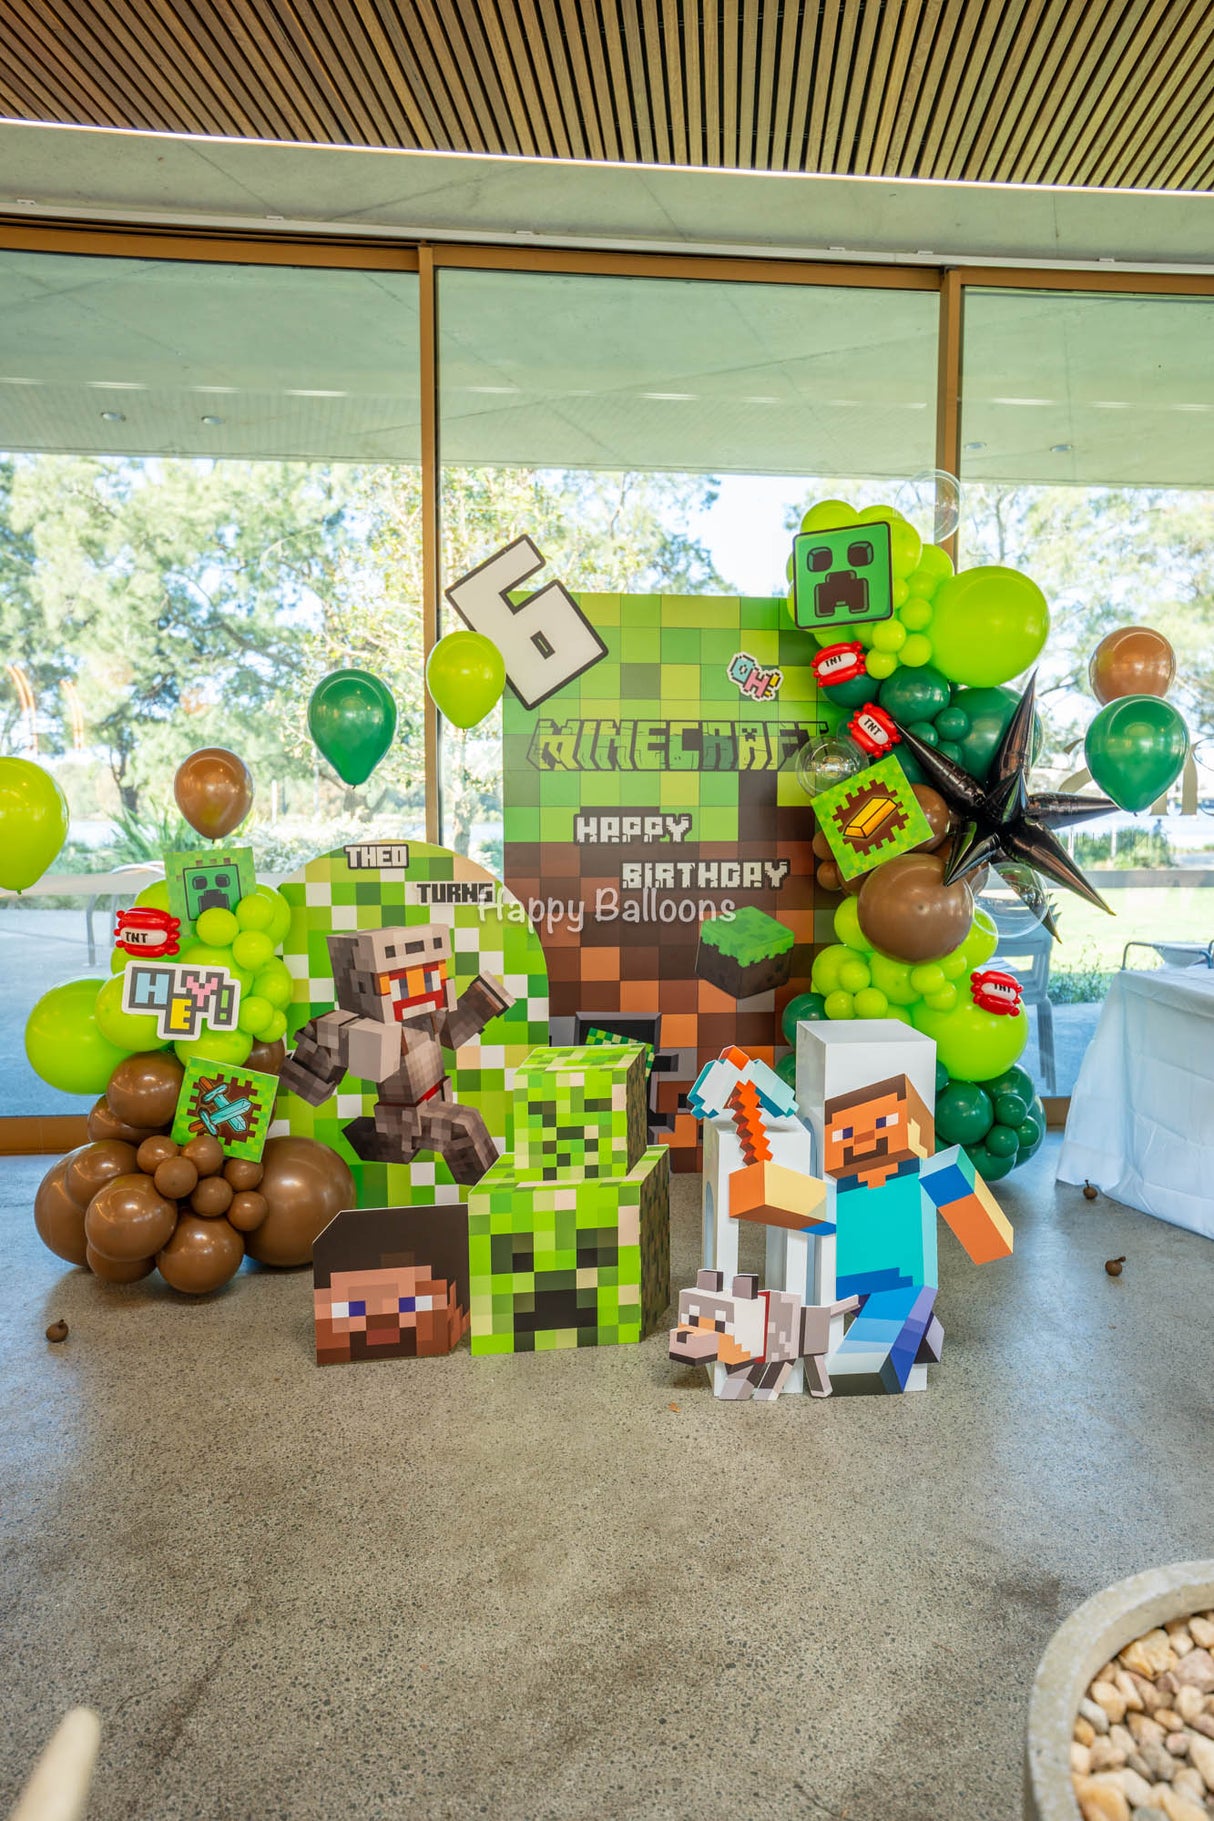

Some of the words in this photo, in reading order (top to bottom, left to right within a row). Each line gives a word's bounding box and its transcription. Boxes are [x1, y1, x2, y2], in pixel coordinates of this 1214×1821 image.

[445, 534, 609, 711] 6
[730, 654, 780, 698] OH!
[863, 716, 882, 736] TNT
[527, 719, 829, 771] MINECRAFT
[576, 815, 690, 842] HAPPY
[345, 846, 407, 868] THEO
[622, 861, 787, 889] BIRTHDAY
[417, 884, 493, 903] TURNS
[125, 931, 148, 944] TNT
[132, 969, 233, 1033] HEY!
